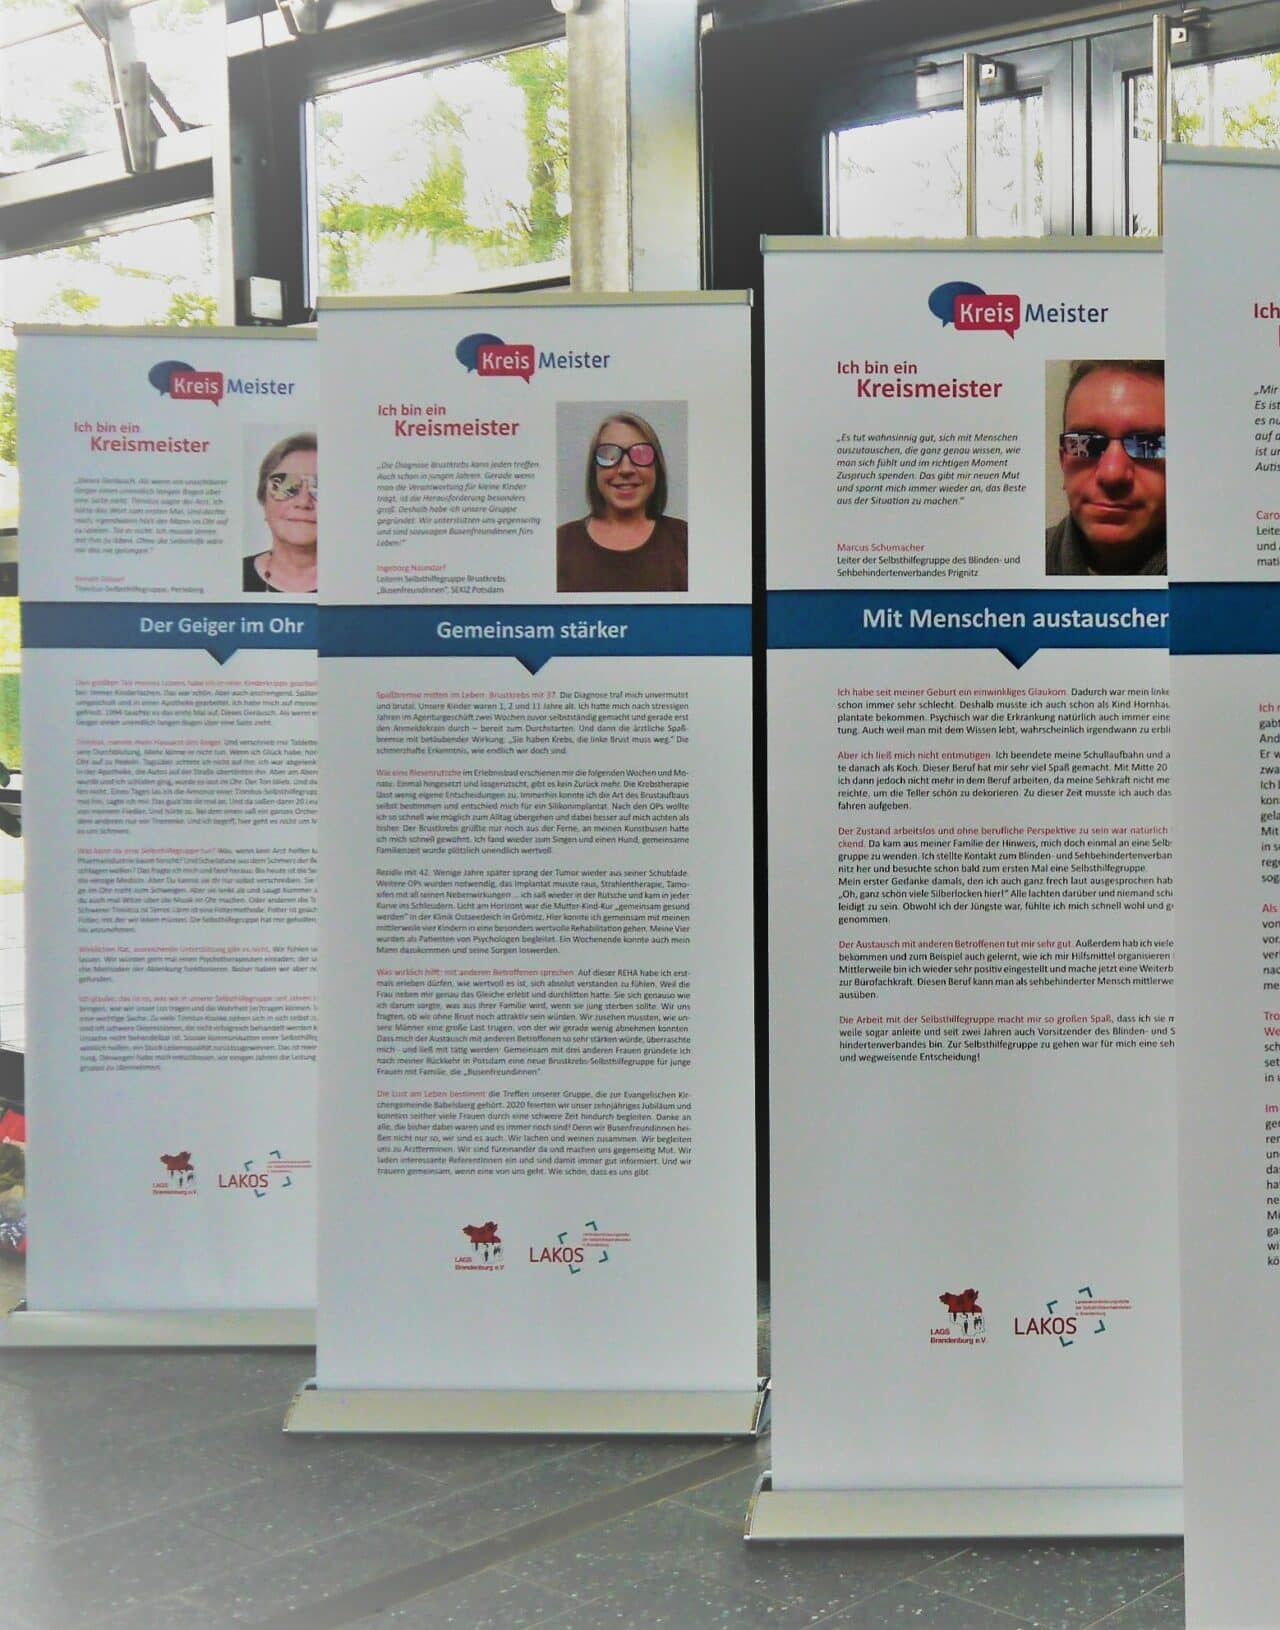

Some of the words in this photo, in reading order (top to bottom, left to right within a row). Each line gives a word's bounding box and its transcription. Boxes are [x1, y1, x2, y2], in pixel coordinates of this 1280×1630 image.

[960, 302, 1014, 323] Kreis
[1025, 302, 1109, 323] Meister
[1254, 302, 1280, 319] Ich
[482, 351, 530, 370] Kreis
[538, 351, 611, 369] Meister
[837, 360, 860, 374] Ich
[864, 360, 889, 374] bin
[893, 360, 918, 375] ein
[174, 378, 219, 394] Kreis
[226, 378, 296, 395] Meister
[857, 378, 1003, 398] Kreismeister
[378, 404, 397, 416] Ich
[401, 404, 422, 416] bin
[425, 403, 446, 416] ein
[74, 421, 93, 434] Ich
[96, 421, 117, 434] bin
[120, 423, 140, 435] ein
[395, 418, 520, 437] Kreismeister
[90, 437, 210, 453] Kreismeister
[853, 434, 866, 442] tut
[867, 432, 918, 444] wahnsinnig
[919, 432, 936, 444] gut,
[938, 432, 956, 443] sich
[957, 433, 972, 444] mit
[973, 432, 1018, 442] Menschen
[837, 543, 869, 553] Marcus
[871, 543, 925, 554] Schumacher
[1257, 541, 1277, 551] und
[837, 556, 861, 565] Leiter
[862, 555, 877, 564] der
[878, 555, 951, 566] Selbsthilfegruppe
[951, 556, 967, 565] des
[968, 555, 1002, 564] Blinden-
[1004, 555, 1021, 564] und
[837, 567, 946, 578] Sehbehindertenverbandes
[948, 567, 980, 579] Prignitz
[863, 608, 902, 628] Mit
[910, 608, 1025, 628] Menschen
[140, 617, 174, 633] Der
[178, 617, 237, 637] Geiger
[241, 617, 264, 633] im
[269, 617, 305, 634] Ohr
[436, 620, 555, 639] Gemeinsam
[560, 619, 629, 639] stärker
[218, 1172, 269, 1188] LAKOS
[529, 1247, 584, 1263] LAKOS
[1014, 1317, 1077, 1336] LAKOS
